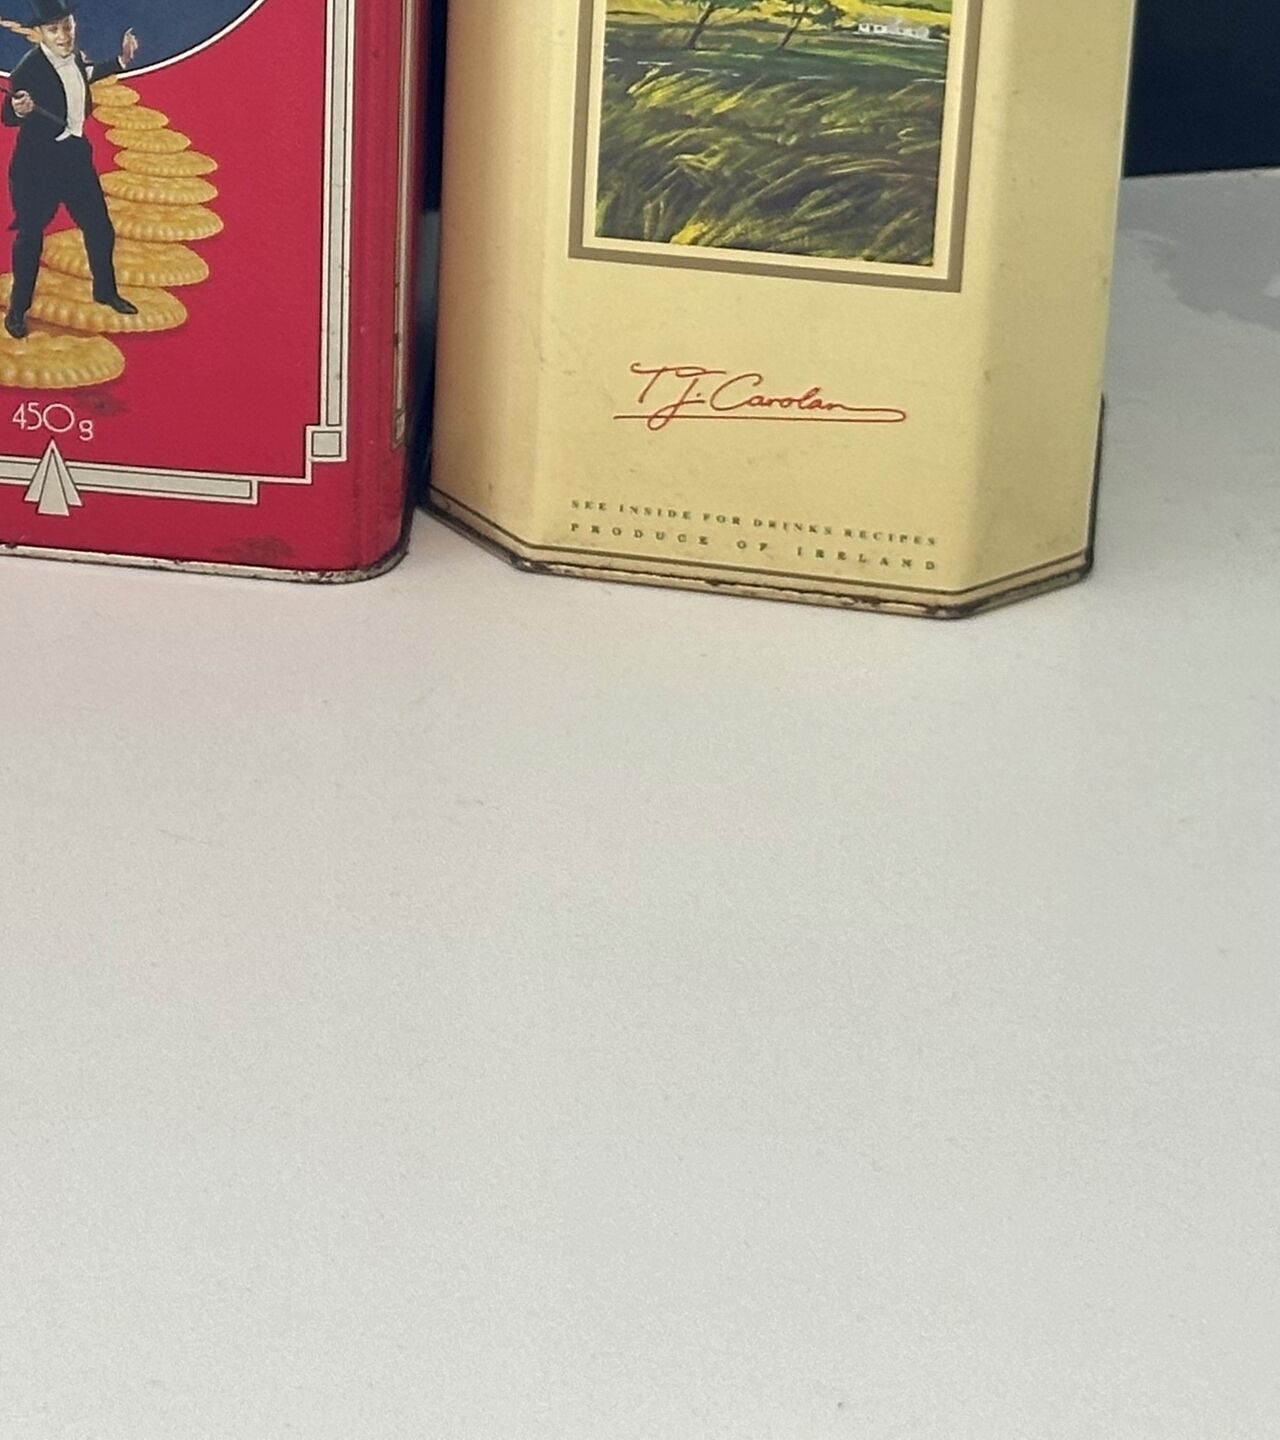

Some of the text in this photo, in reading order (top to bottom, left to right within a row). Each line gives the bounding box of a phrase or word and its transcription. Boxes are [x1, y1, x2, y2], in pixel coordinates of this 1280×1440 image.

[710, 372, 875, 416] Carolan
[12, 402, 94, 442] 450g
[571, 499, 937, 547] SEE INSIDE FOR DRINKS RECIPES
[571, 522, 936, 571] PRODUCE OF IRELAND
